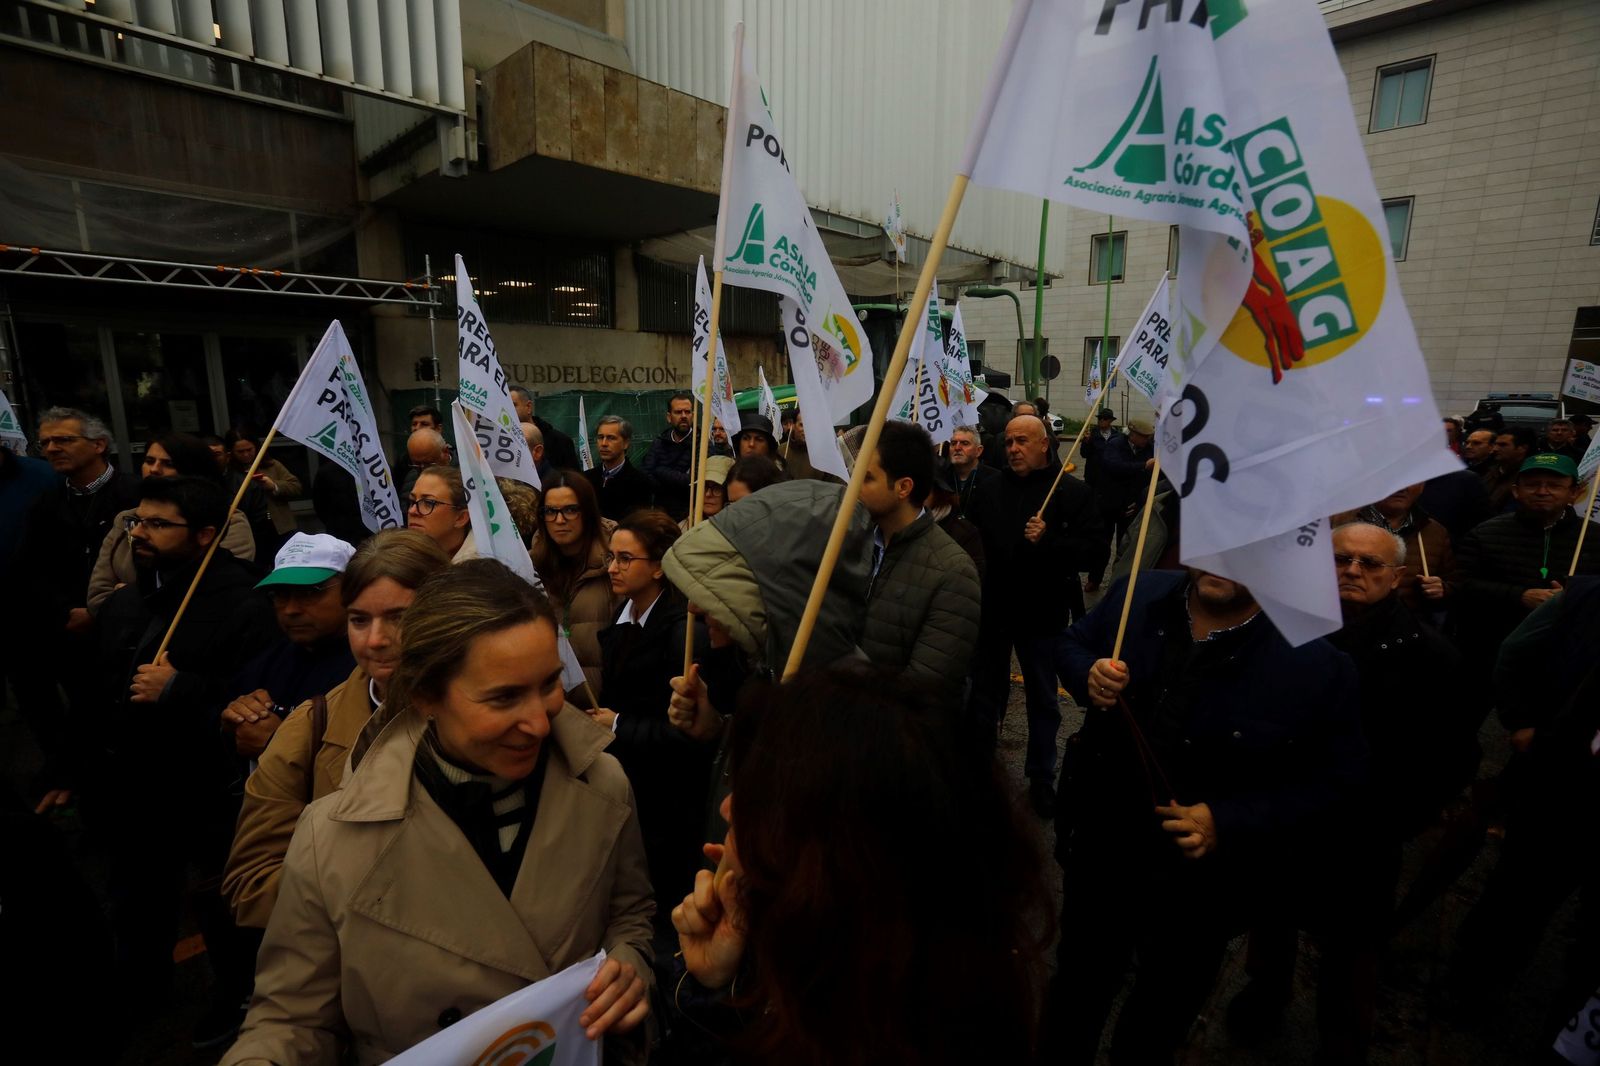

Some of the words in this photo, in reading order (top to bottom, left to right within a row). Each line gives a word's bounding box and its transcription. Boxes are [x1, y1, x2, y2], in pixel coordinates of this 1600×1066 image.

[1174, 107, 1236, 154] AS
[1064, 175, 1130, 199] Asociación
[1240, 122, 1357, 347] COAG
[927, 300, 943, 341] UPA
[1136, 330, 1169, 370] PARA
[502, 364, 677, 384] SUBDELEGACION
[459, 387, 487, 408] órdoba
